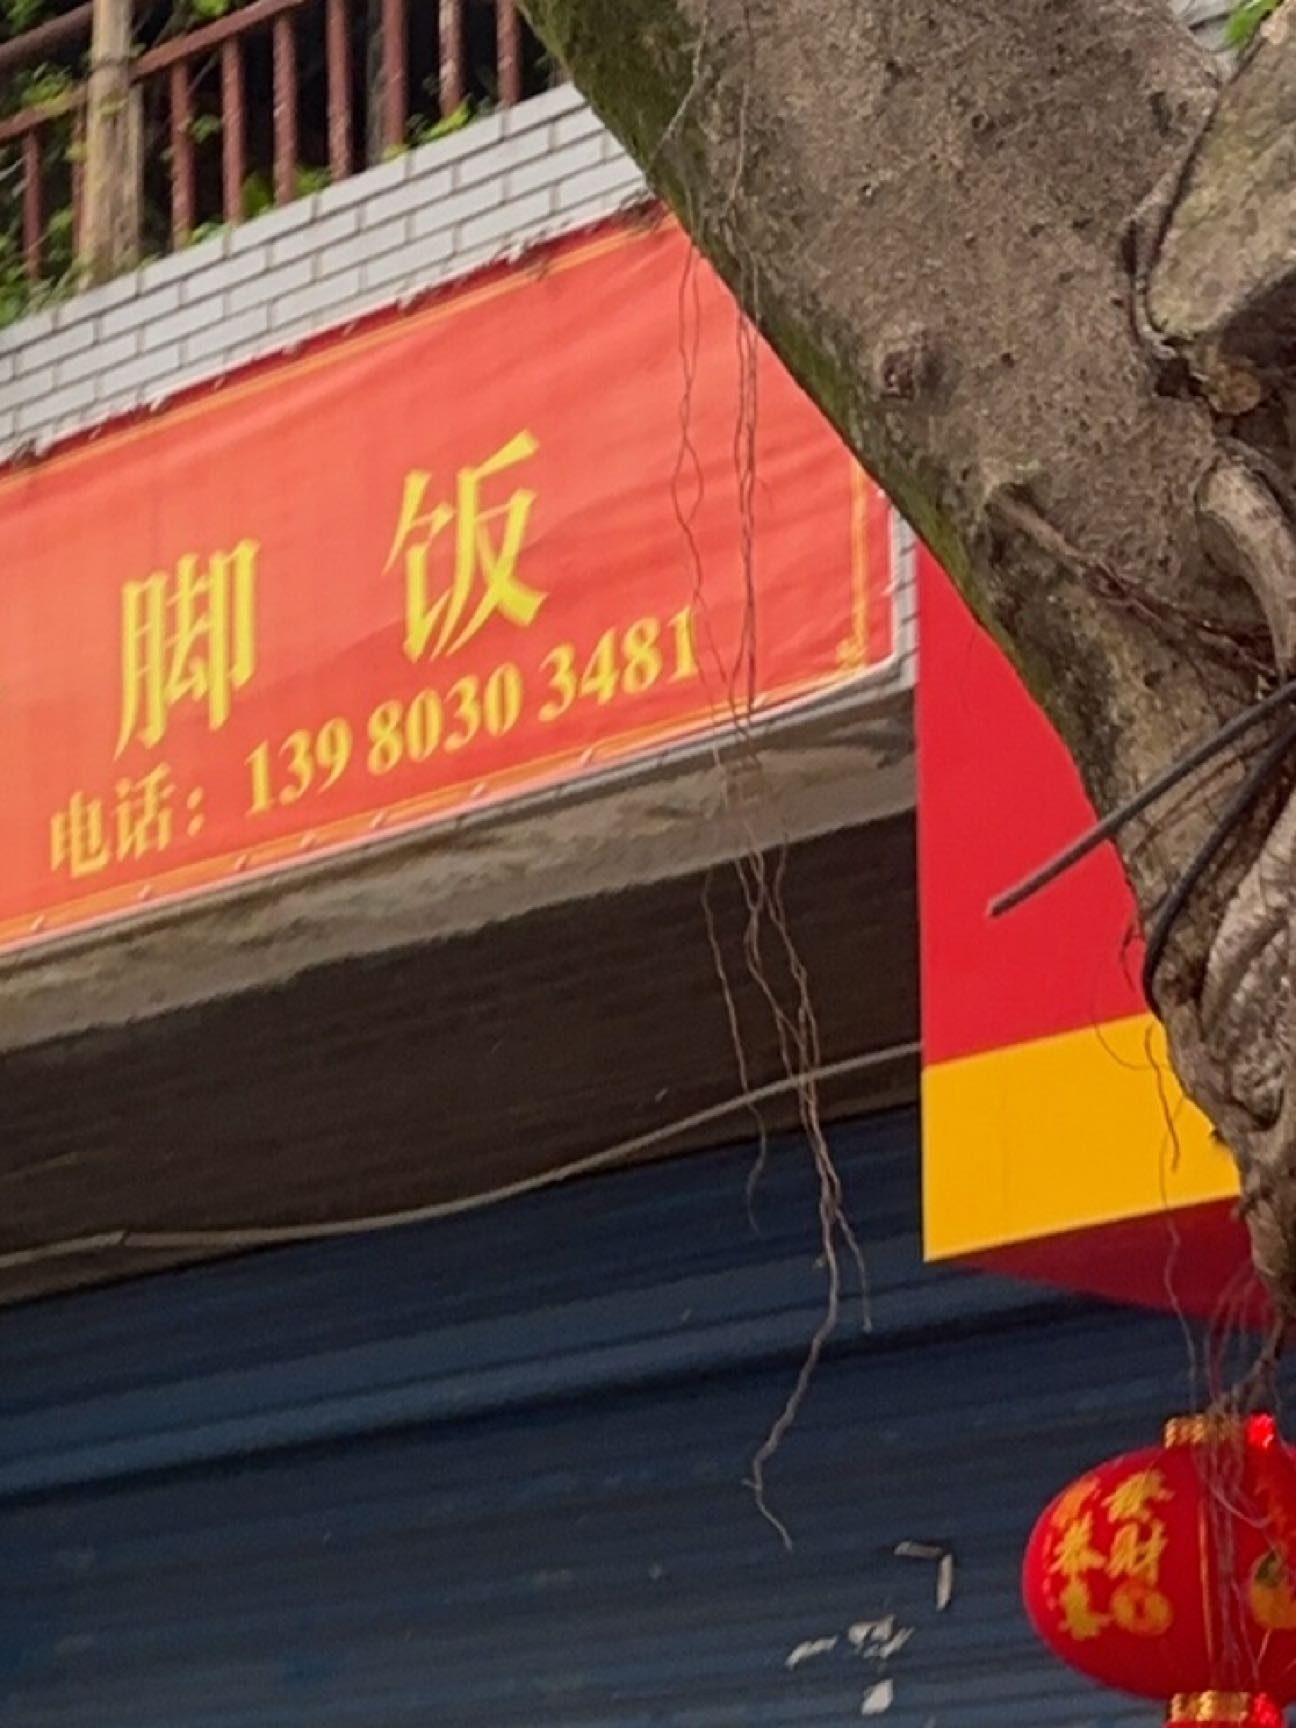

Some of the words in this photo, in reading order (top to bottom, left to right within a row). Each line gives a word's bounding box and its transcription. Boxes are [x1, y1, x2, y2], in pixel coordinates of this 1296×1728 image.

[245, 718, 354, 818] 139
[367, 662, 523, 777] 8030
[539, 603, 703, 723] 3481
